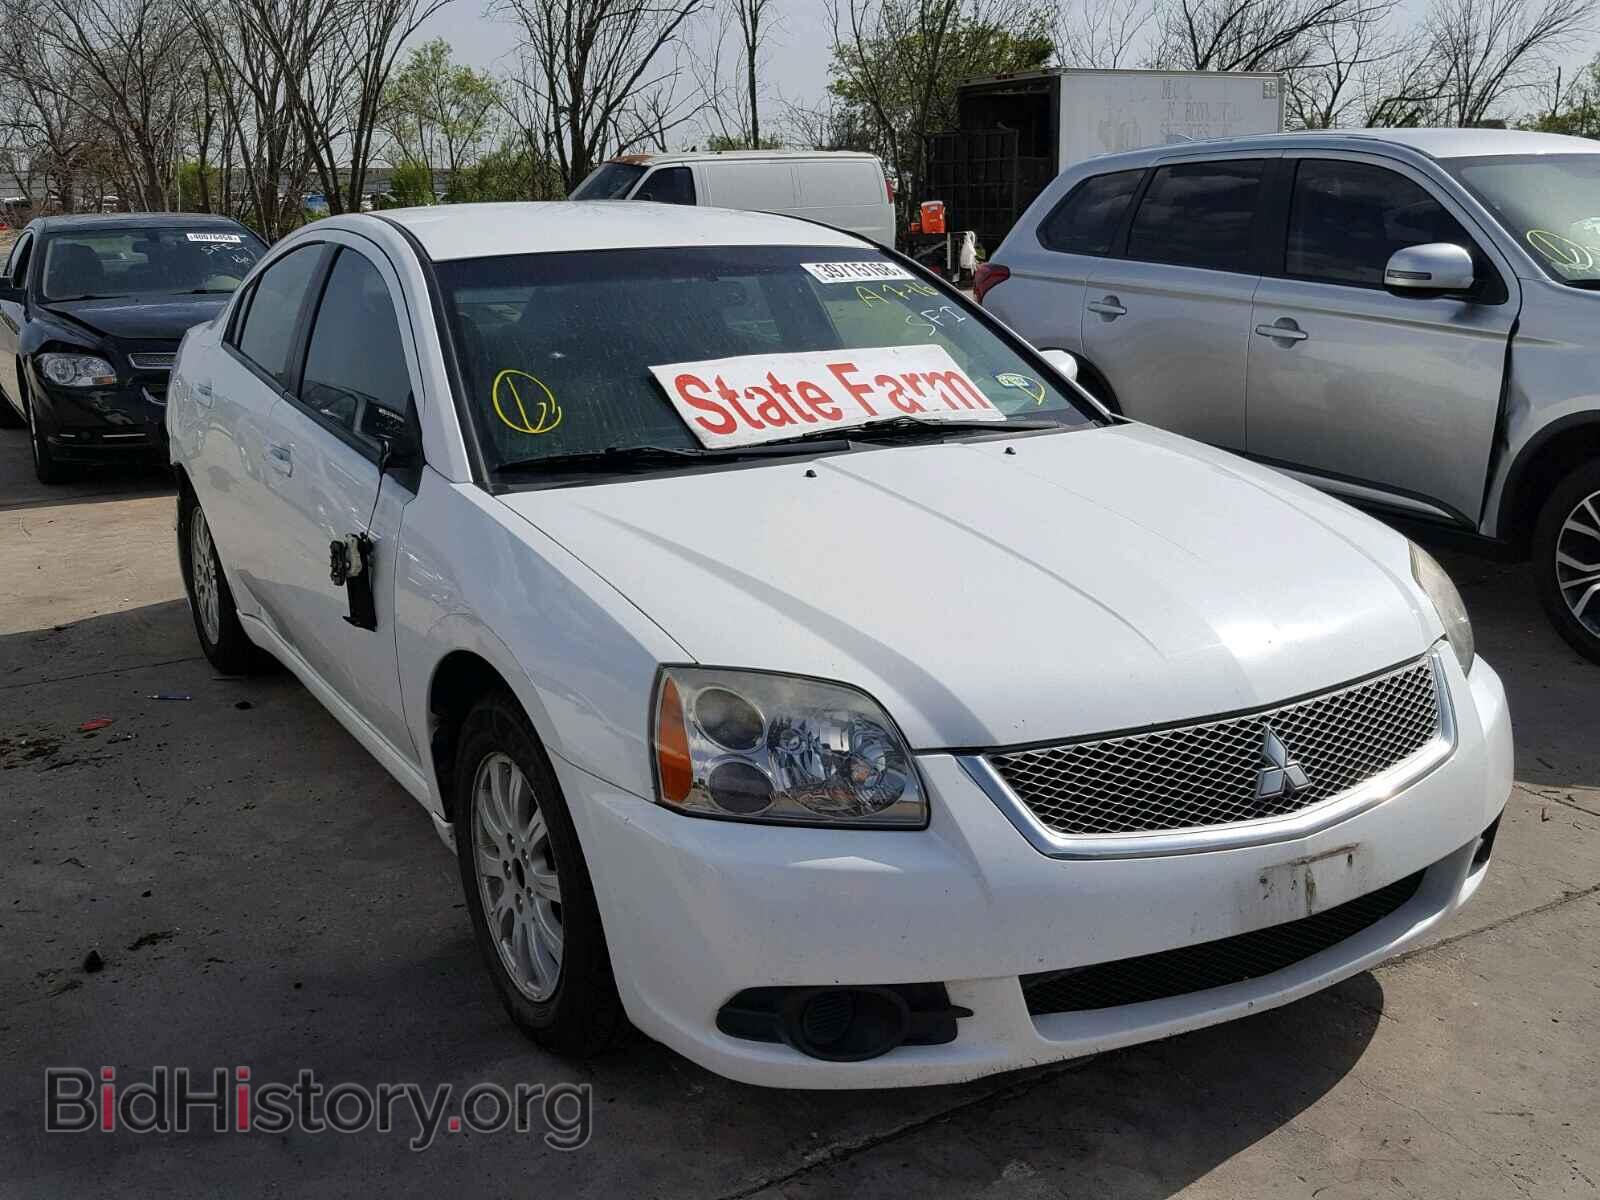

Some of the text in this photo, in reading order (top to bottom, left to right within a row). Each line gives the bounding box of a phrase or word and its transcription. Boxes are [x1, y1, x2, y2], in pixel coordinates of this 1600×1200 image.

[814, 262, 898, 279] 39715168
[674, 362, 991, 435] State Farm
